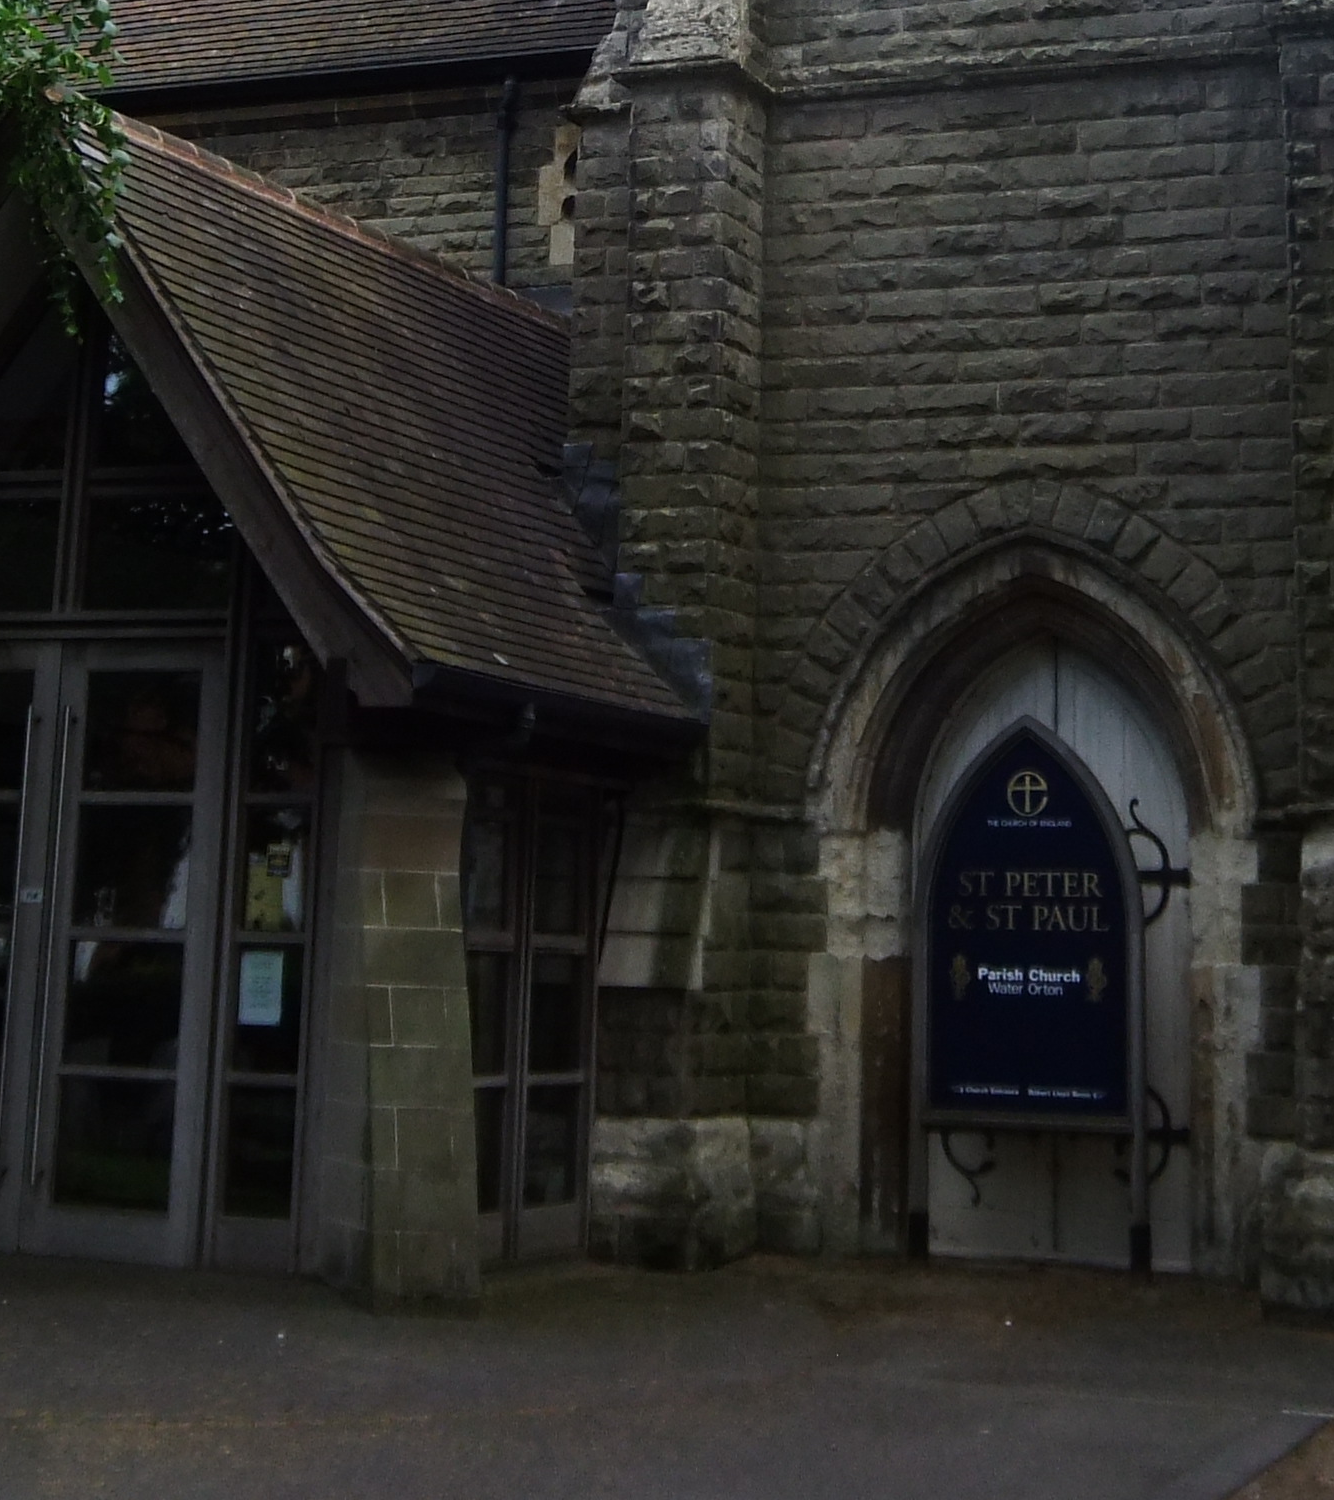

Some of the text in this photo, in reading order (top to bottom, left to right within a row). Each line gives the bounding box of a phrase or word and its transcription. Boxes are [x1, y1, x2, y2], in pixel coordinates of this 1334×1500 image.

[987, 819, 1072, 828] THE CHURCH OF ENGLAND
[959, 872, 1103, 898] ST PETER
[948, 904, 1110, 932] & ST PAUL
[977, 967, 1081, 983] Parish Church
[987, 983, 1064, 996] Water Orton
